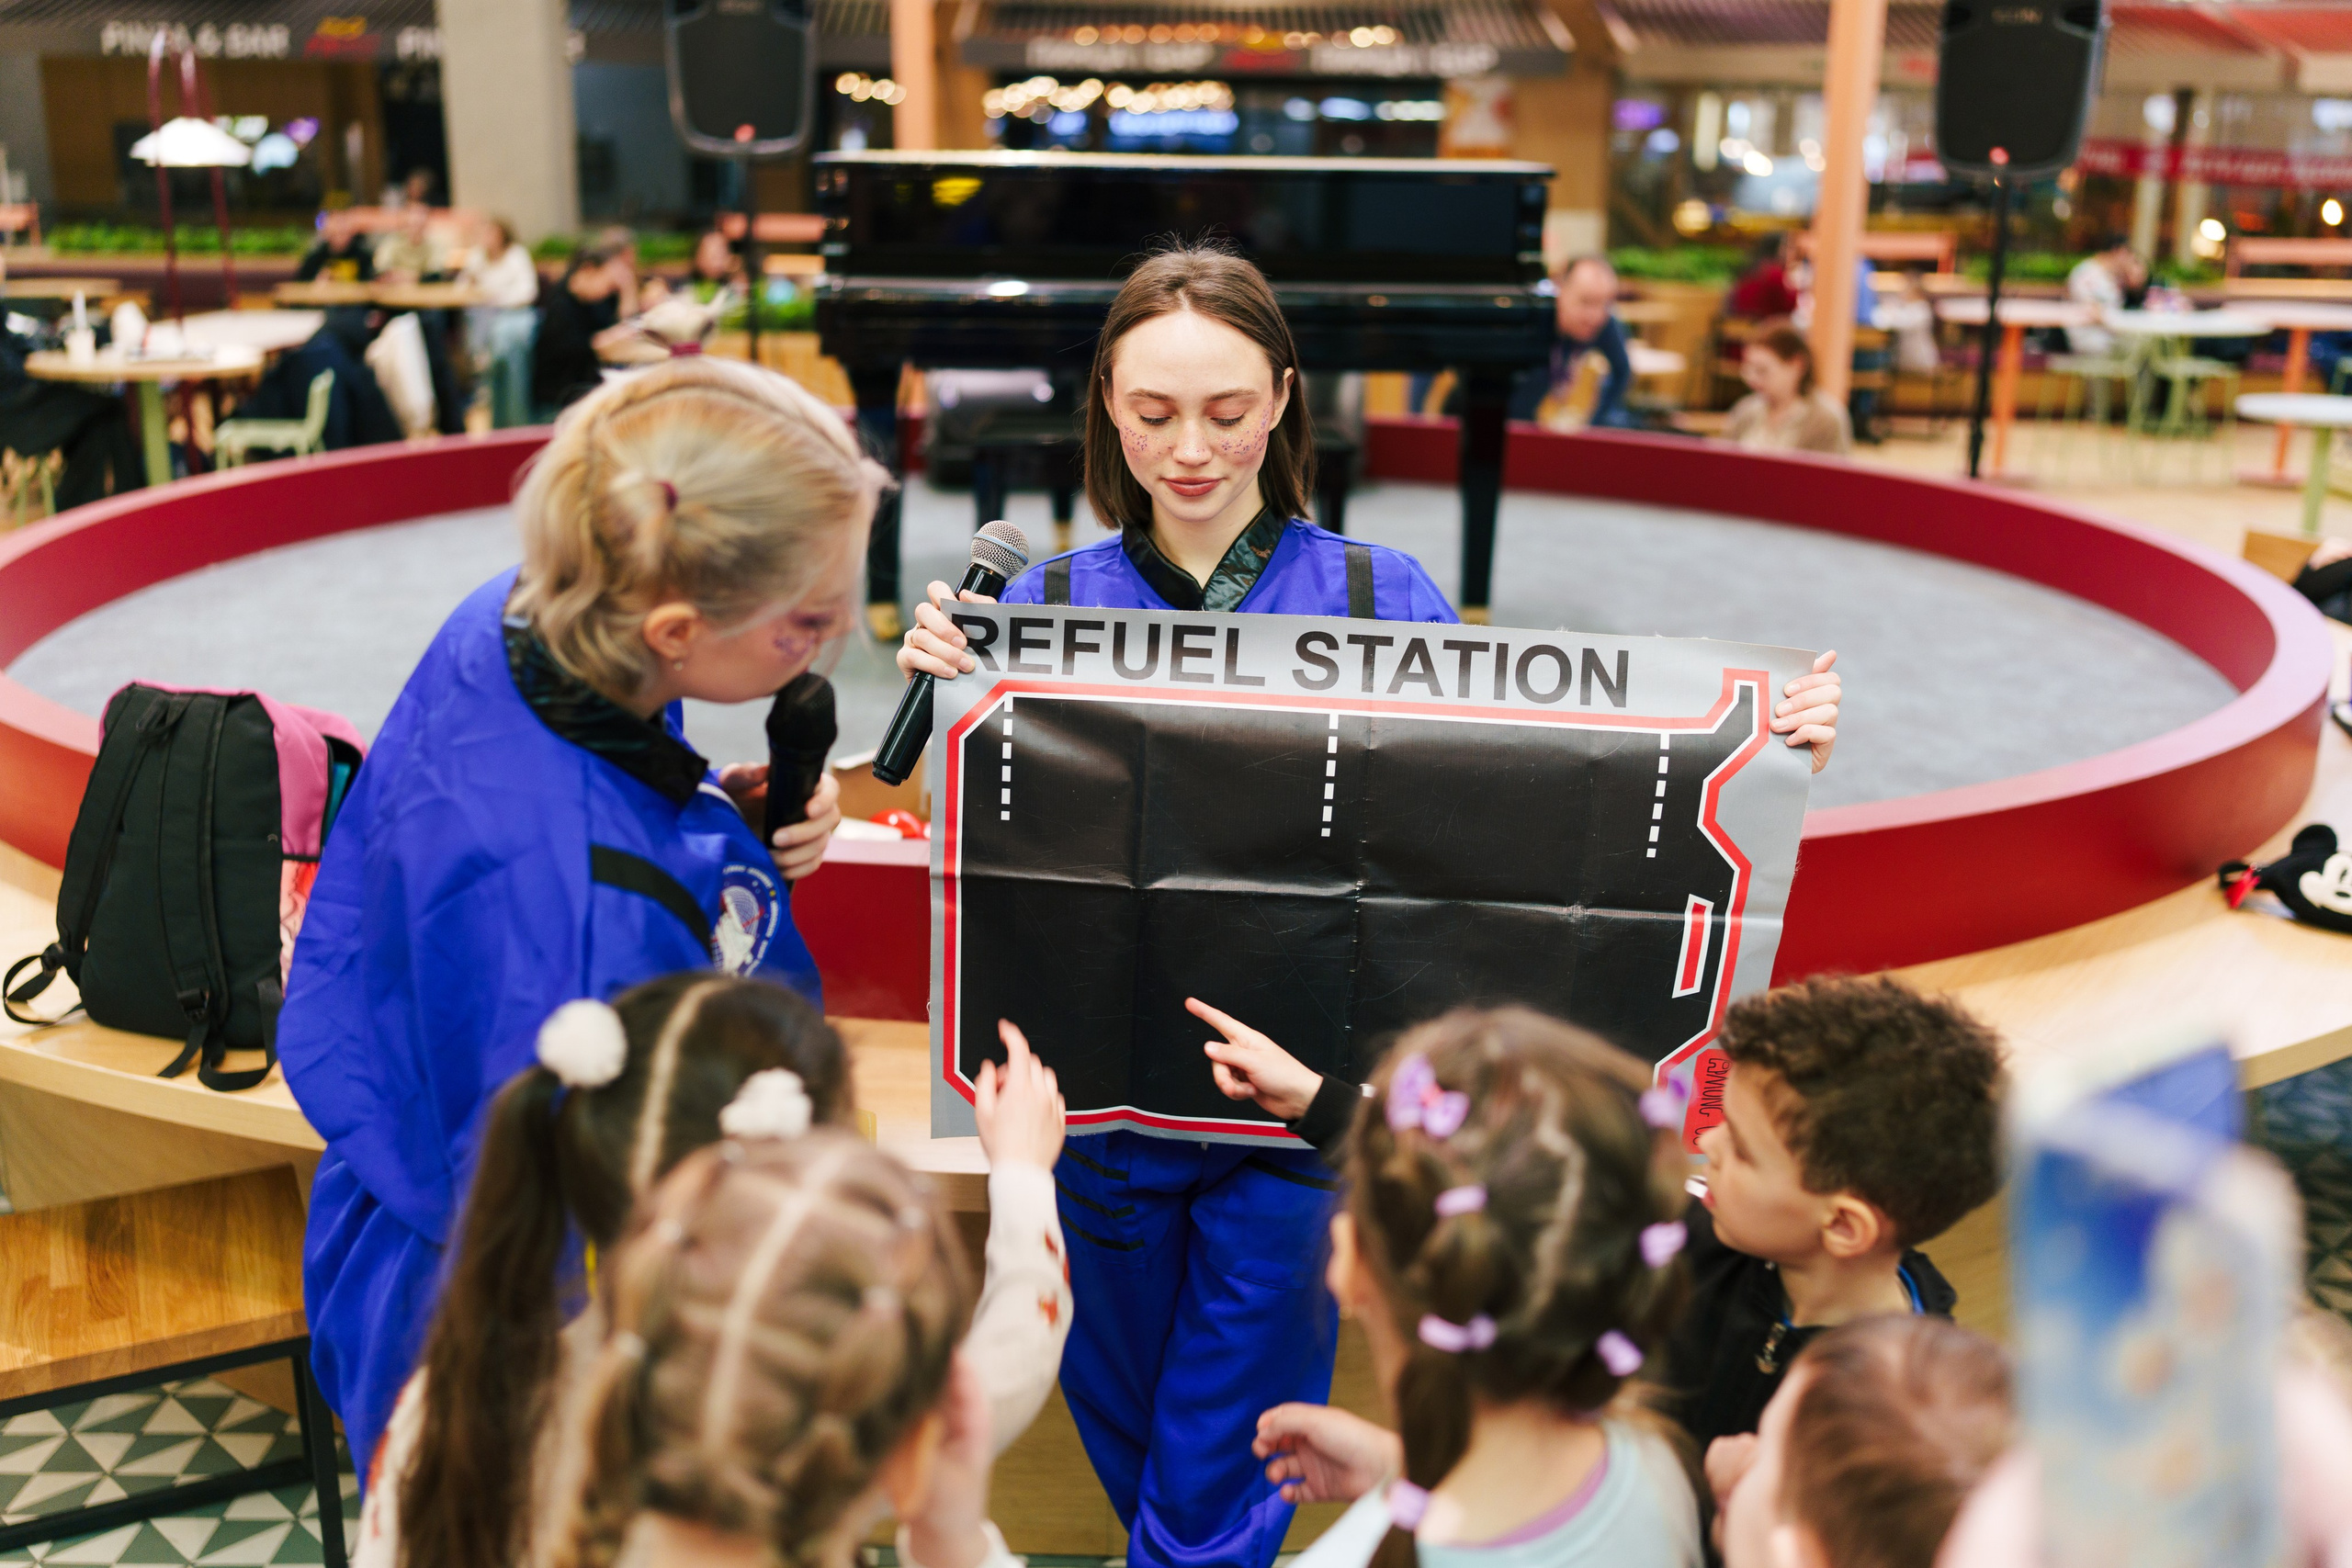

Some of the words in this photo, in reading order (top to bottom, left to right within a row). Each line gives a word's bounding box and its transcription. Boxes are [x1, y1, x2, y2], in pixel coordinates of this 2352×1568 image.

[224, 22, 291, 60] BAR
[952, 613, 1267, 688] REFUEL
[1291, 628, 1630, 710] STATION
